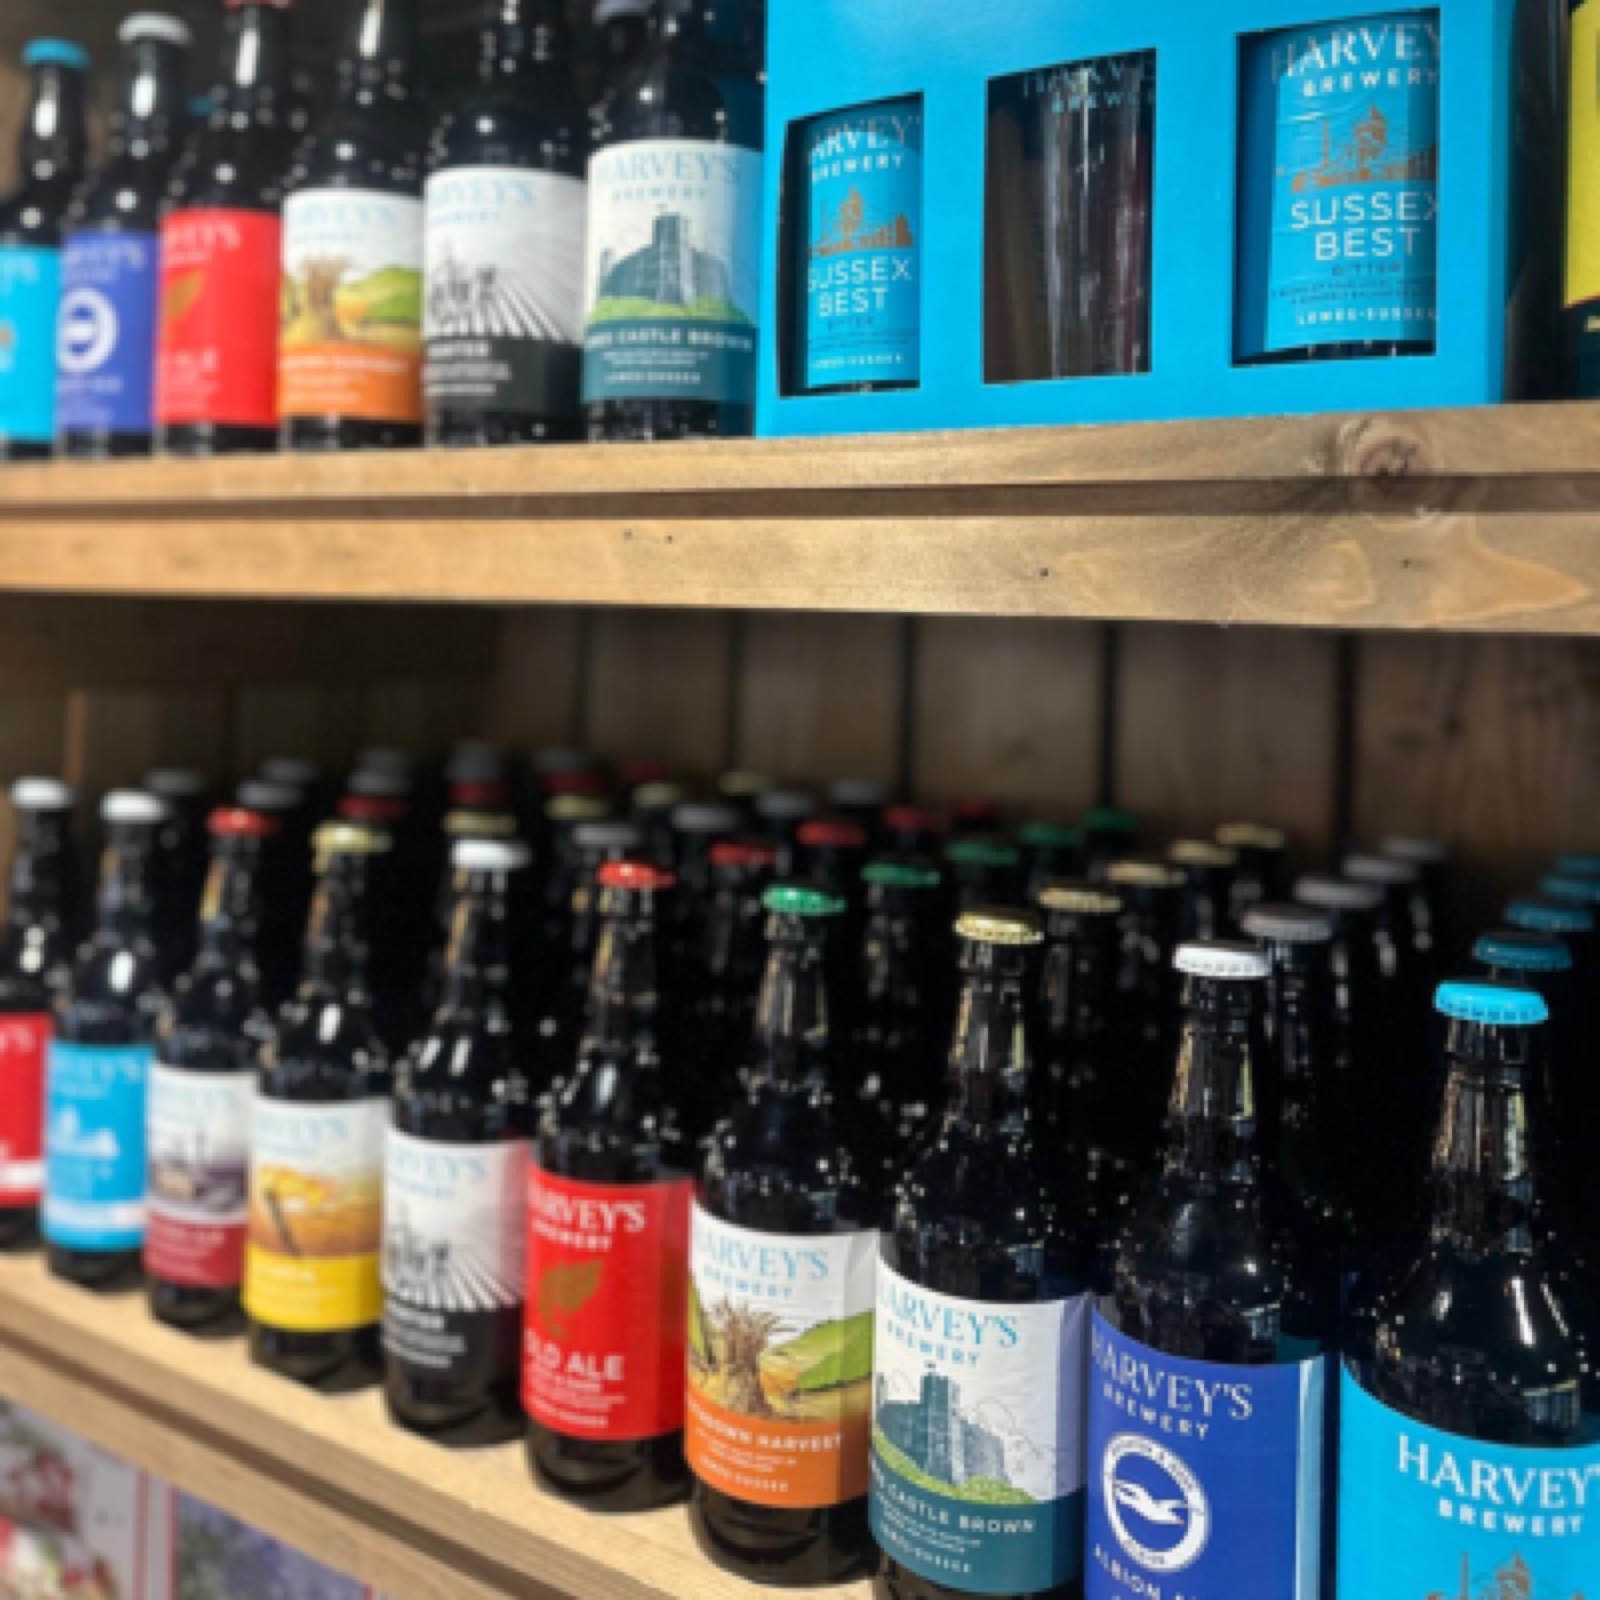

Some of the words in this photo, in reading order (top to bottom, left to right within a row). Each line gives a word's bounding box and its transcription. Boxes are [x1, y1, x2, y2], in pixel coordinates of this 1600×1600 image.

[1314, 227, 1421, 261] BEST
[818, 286, 889, 318] BEST
[566, 1351, 626, 1382] ALE
